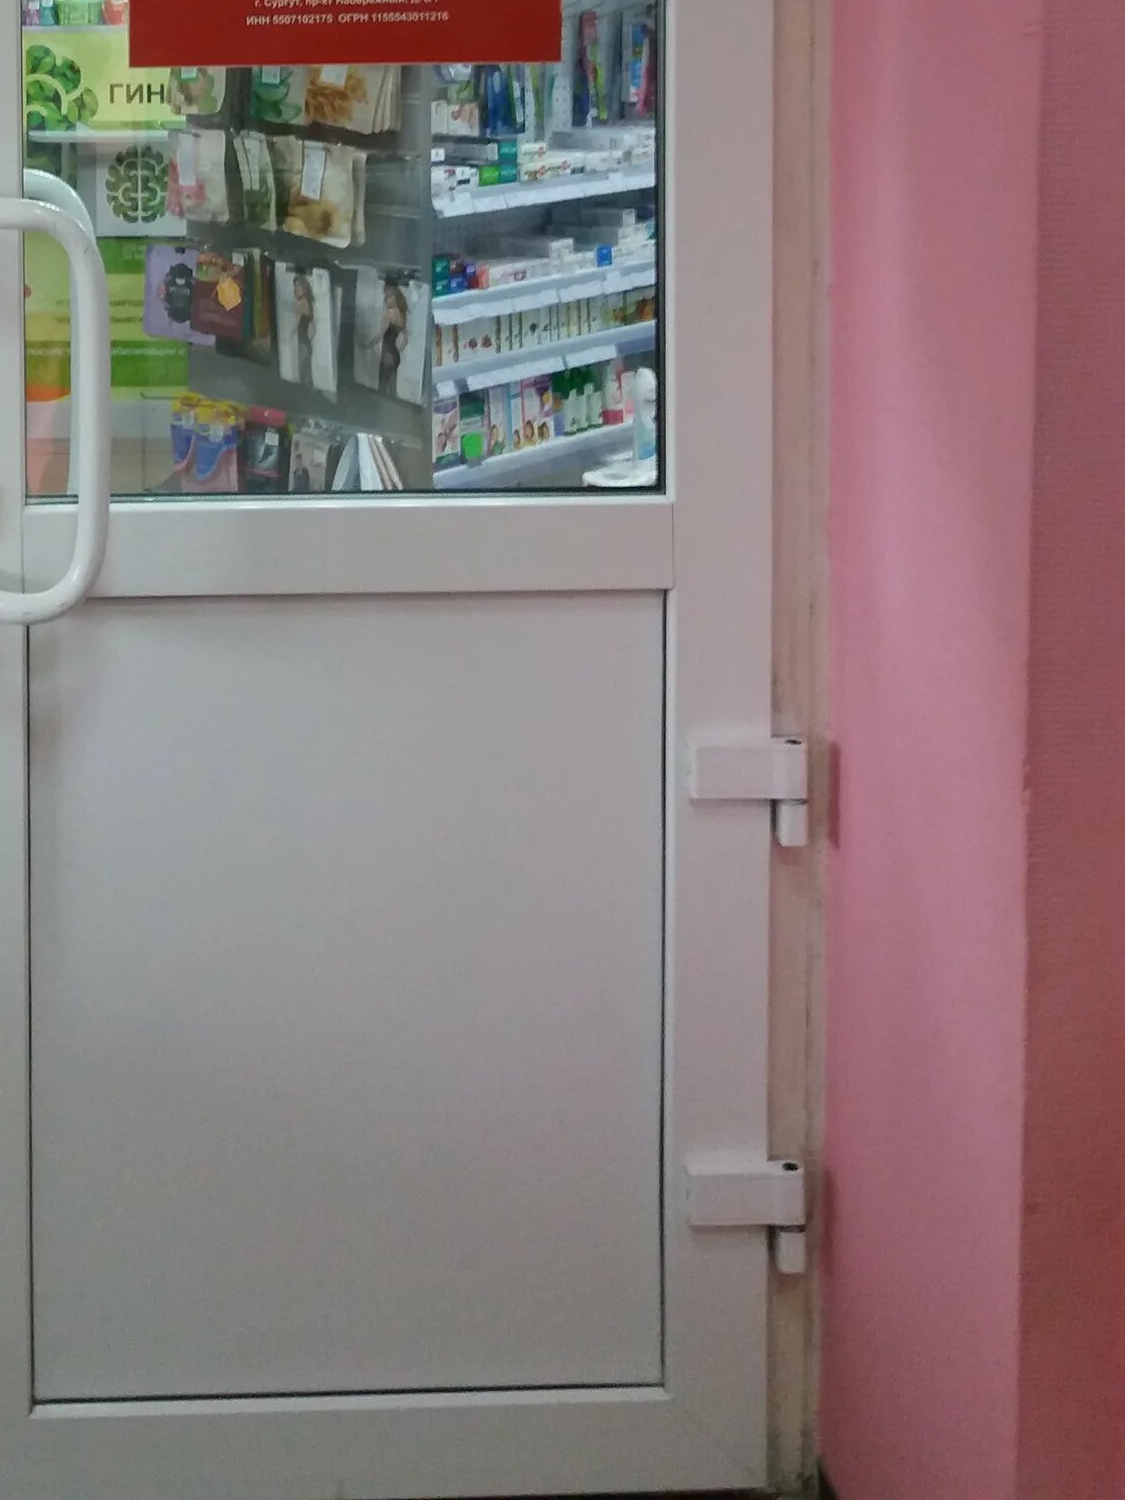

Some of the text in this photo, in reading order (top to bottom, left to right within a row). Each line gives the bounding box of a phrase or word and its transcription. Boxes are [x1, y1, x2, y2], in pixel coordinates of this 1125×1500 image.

[246, 15, 270, 27] ИНН
[338, 12, 369, 24] ОГРН
[108, 82, 170, 105] ГИН
